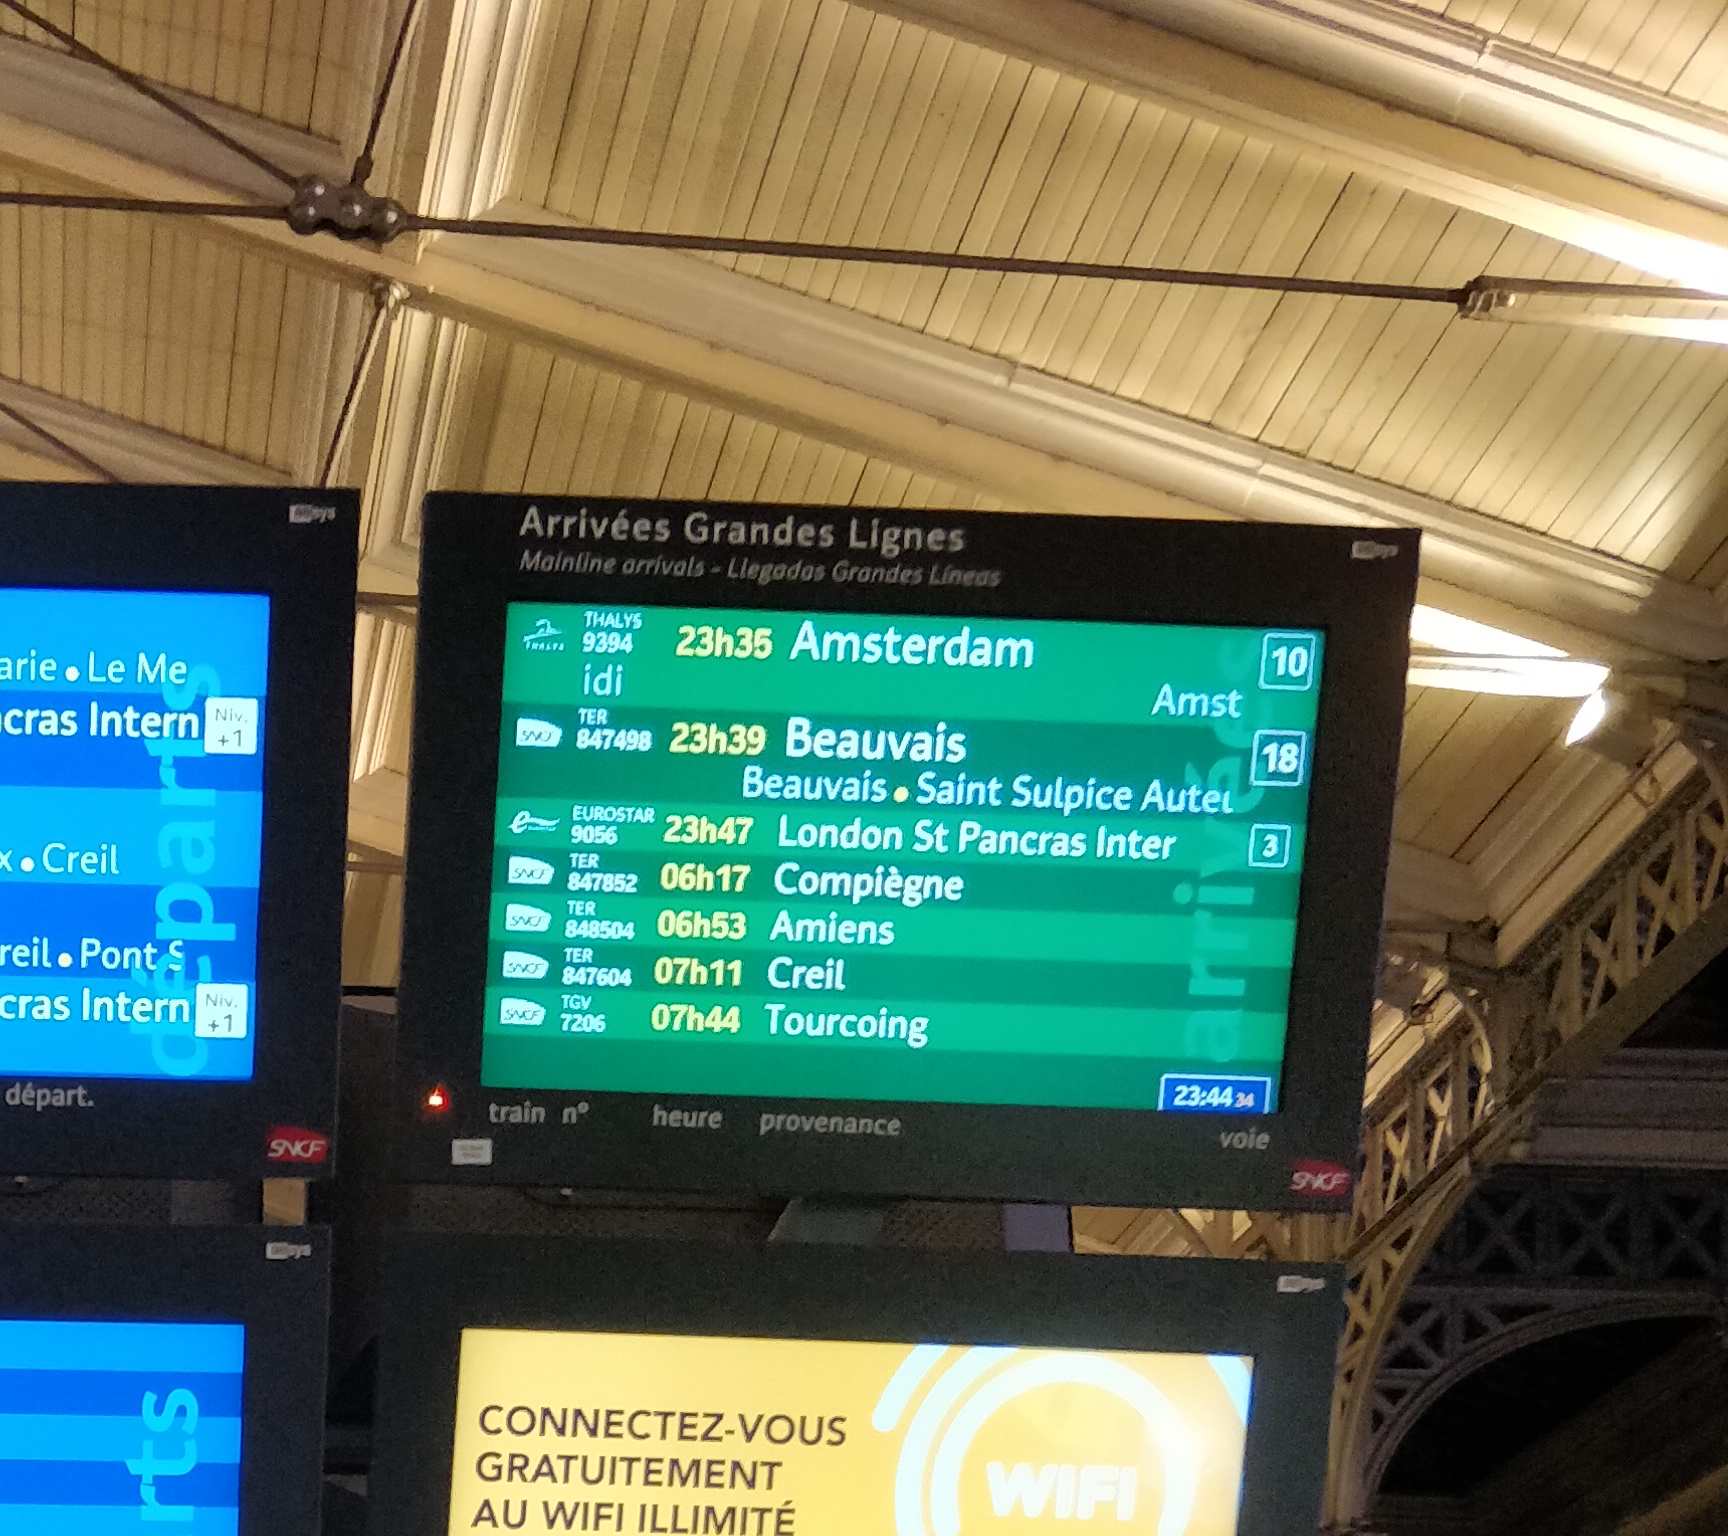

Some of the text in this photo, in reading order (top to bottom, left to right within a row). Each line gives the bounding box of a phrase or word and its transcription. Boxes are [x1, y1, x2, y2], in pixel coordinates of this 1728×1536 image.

[520, 505, 966, 557] Arrivées Grandes Lignes
[676, 620, 1308, 678] 23h35 Amsterdam 10
[89, 701, 199, 739] Intern
[669, 716, 1300, 774] 23h39 Beauvais 18
[663, 815, 754, 845] 23h47
[778, 814, 903, 851] London
[914, 819, 949, 853] St
[959, 822, 1086, 858] Pancras
[1097, 825, 1177, 859] Inter
[660, 862, 964, 907] 06h17 Compiègne
[657, 909, 895, 946] 06h53 Amiens
[654, 957, 845, 991] 07h11 Creil
[82, 988, 190, 1023] Intern
[651, 1003, 929, 1050] 07h44 Tourcoing
[6, 1084, 94, 1112] départ.
[1173, 1084, 1234, 1108] 23:44
[489, 1101, 1270, 1151] train n° heure provenance voie
[268, 1138, 326, 1158] SNCF
[478, 1404, 848, 1447] CONNECTEZ-VOUS
[475, 1451, 783, 1491] GRATUITEMENT
[986, 1461, 1138, 1521] WIFI
[471, 1499, 527, 1531] AU
[542, 1501, 624, 1533] WIFI
